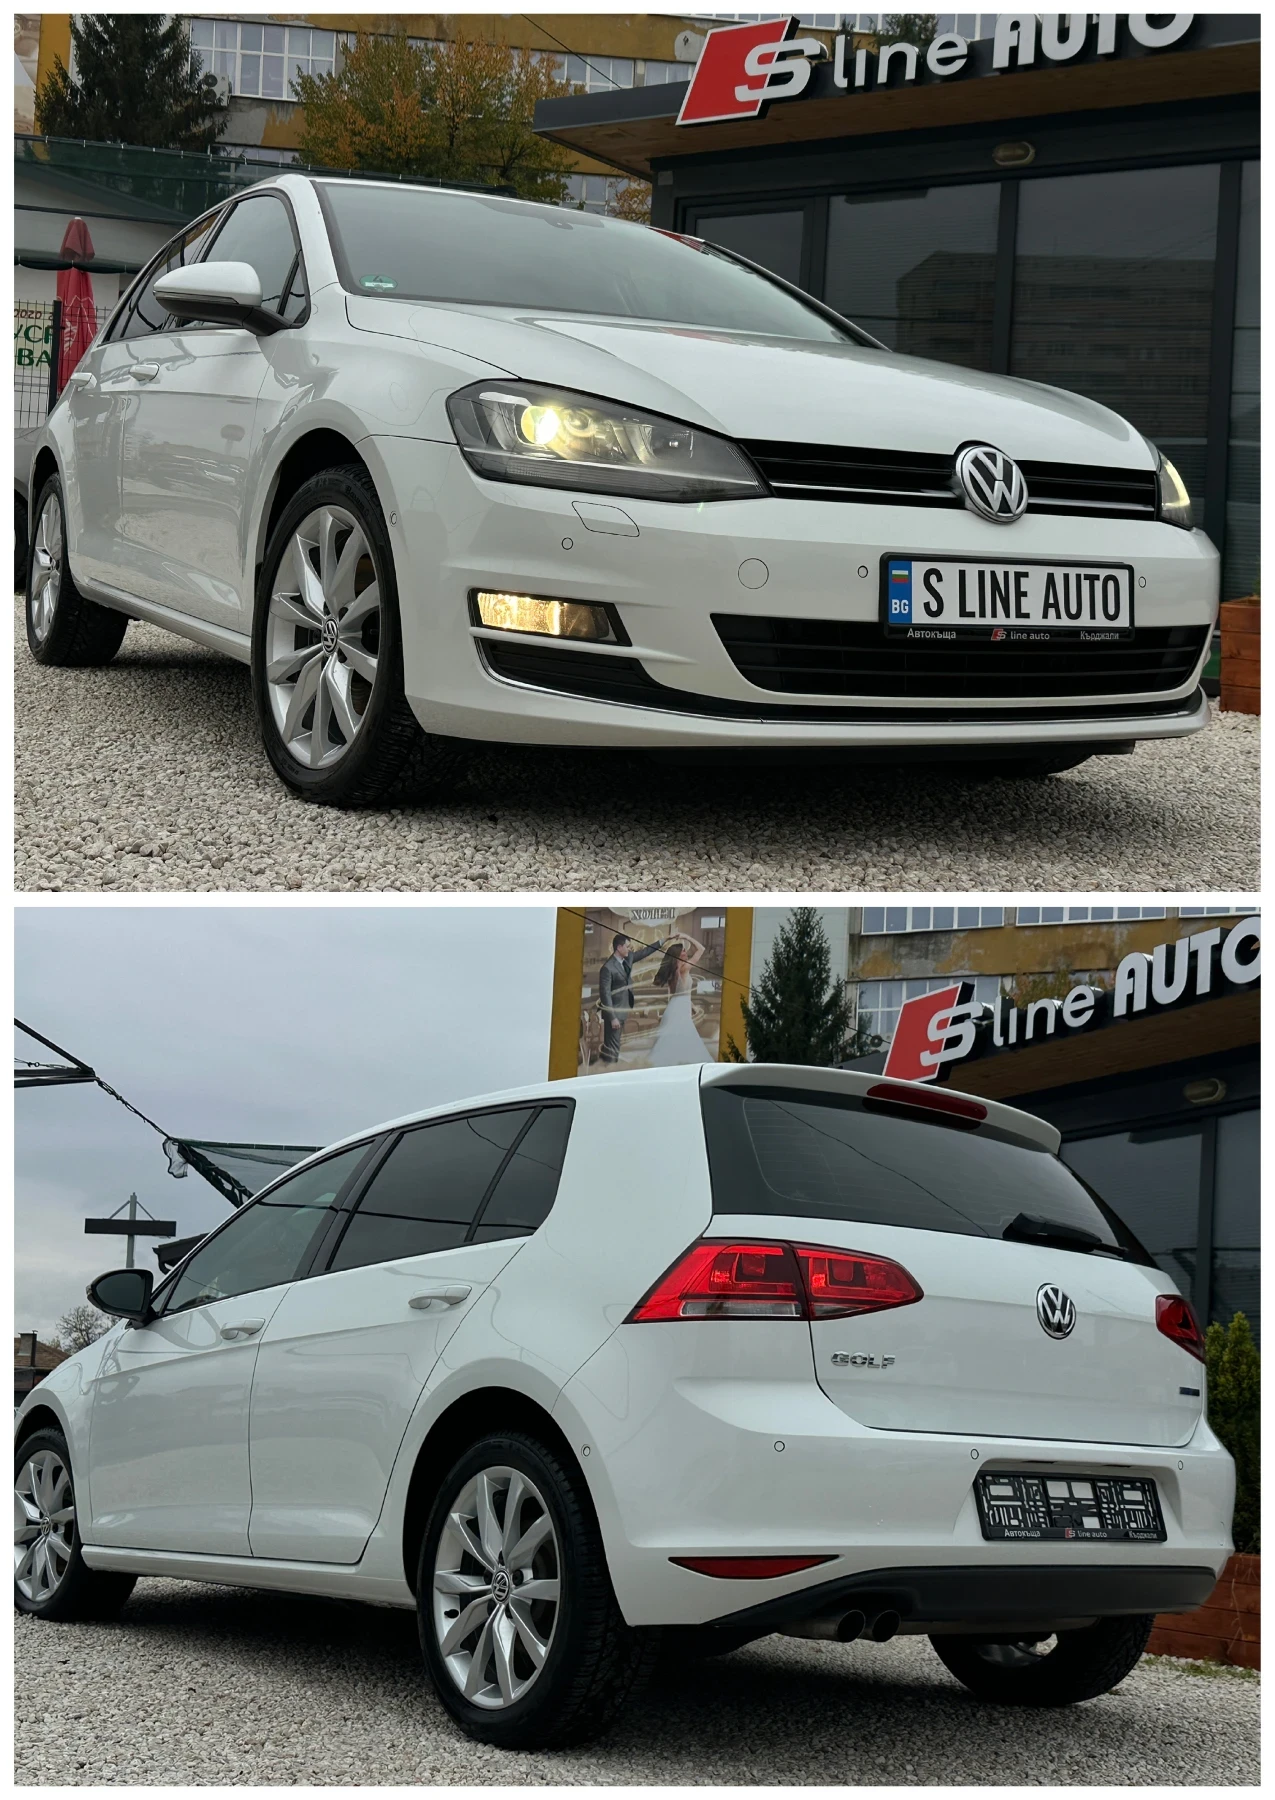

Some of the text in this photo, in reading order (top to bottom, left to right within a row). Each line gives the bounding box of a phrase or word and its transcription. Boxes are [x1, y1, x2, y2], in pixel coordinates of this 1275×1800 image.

[734, 37, 820, 102] S
[833, 34, 967, 89] line
[964, 447, 1027, 519] VW
[922, 567, 1121, 622] S LINE AUTO
[891, 599, 909, 614] BG
[906, 628, 957, 640] Автокъща
[1010, 630, 1027, 640] line
[1029, 632, 1050, 640] auto
[919, 916, 1261, 1068] S line AUTO
[830, 1350, 896, 1369] GOLF
[1004, 1528, 1041, 1539] Автокъща
[1091, 1531, 1108, 1539] auto
